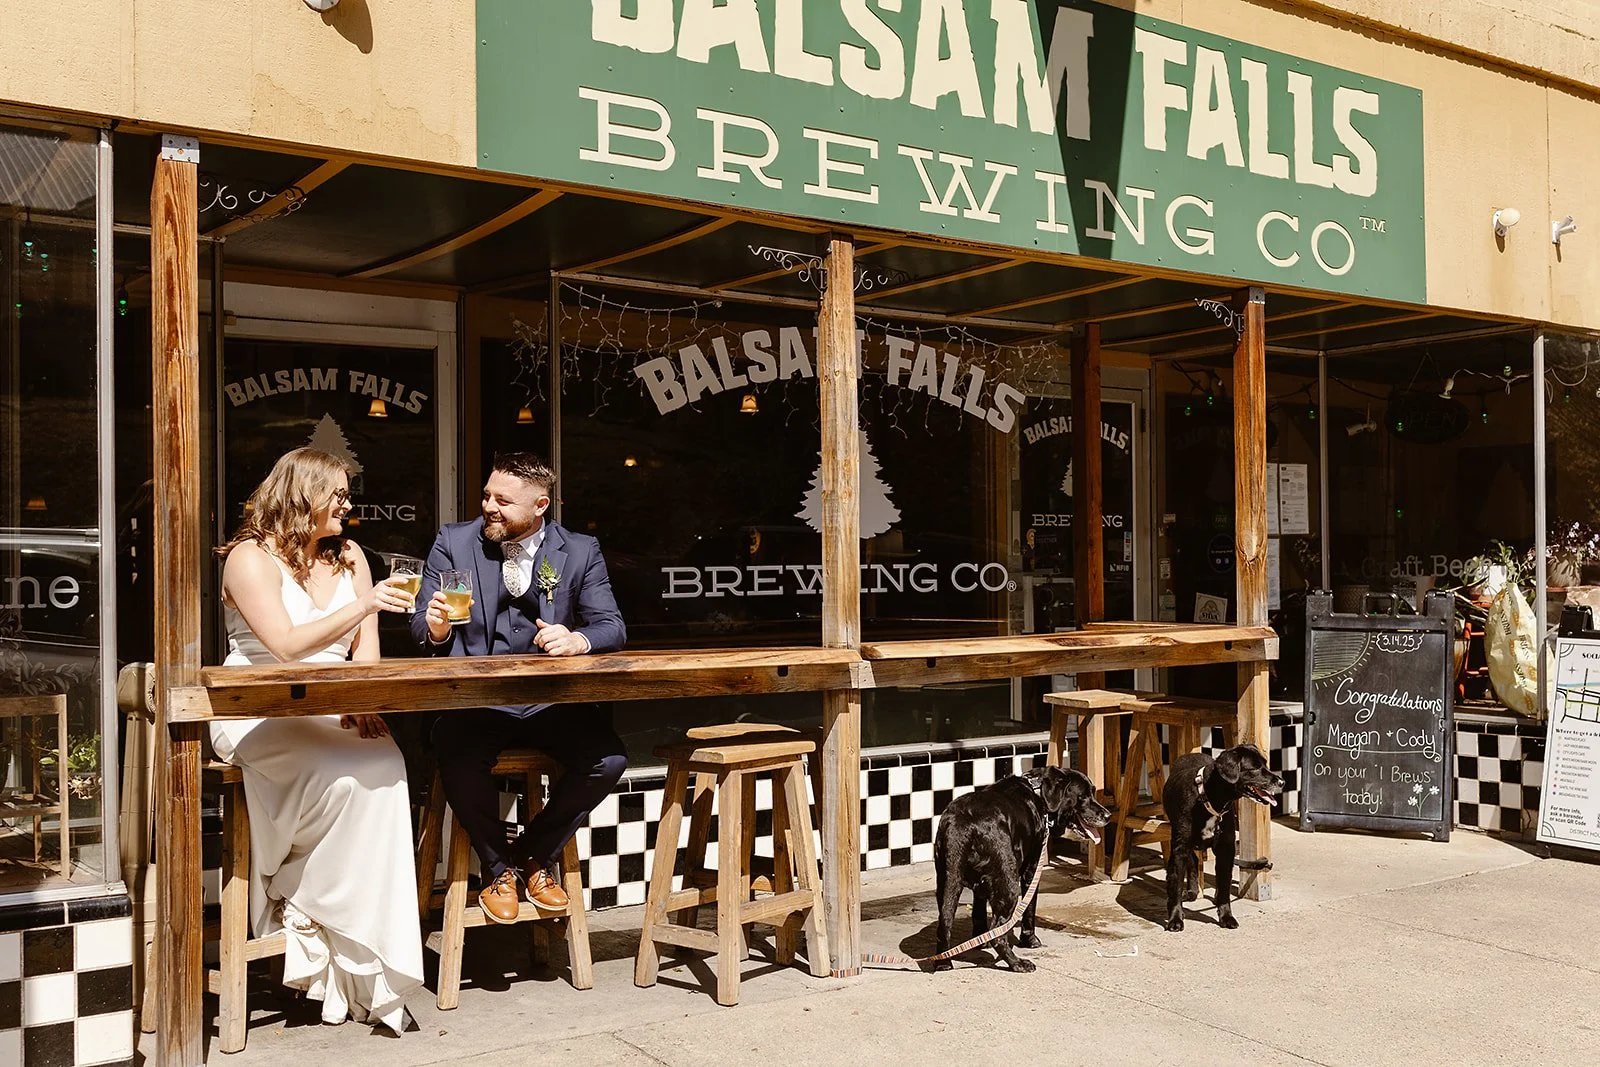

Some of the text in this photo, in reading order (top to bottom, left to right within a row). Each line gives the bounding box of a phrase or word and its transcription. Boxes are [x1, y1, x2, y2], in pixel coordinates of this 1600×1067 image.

[1135, 27, 1379, 197] FALLS
[579, 86, 1215, 256] BREWING
[224, 368, 428, 414] BALSAM FALLS
[885, 334, 1026, 434] FALLS
[1361, 554, 1424, 578] Craft
[1382, 634, 1415, 648] 3.14.25
[1334, 677, 1443, 724] Congratulations
[1327, 723, 1381, 760] Maegan
[1396, 728, 1436, 760] Cody
[1314, 763, 1332, 776] On
[1338, 766, 1367, 788] your
[1342, 787, 1384, 815] today!
[1575, 819, 1587, 827] Code
